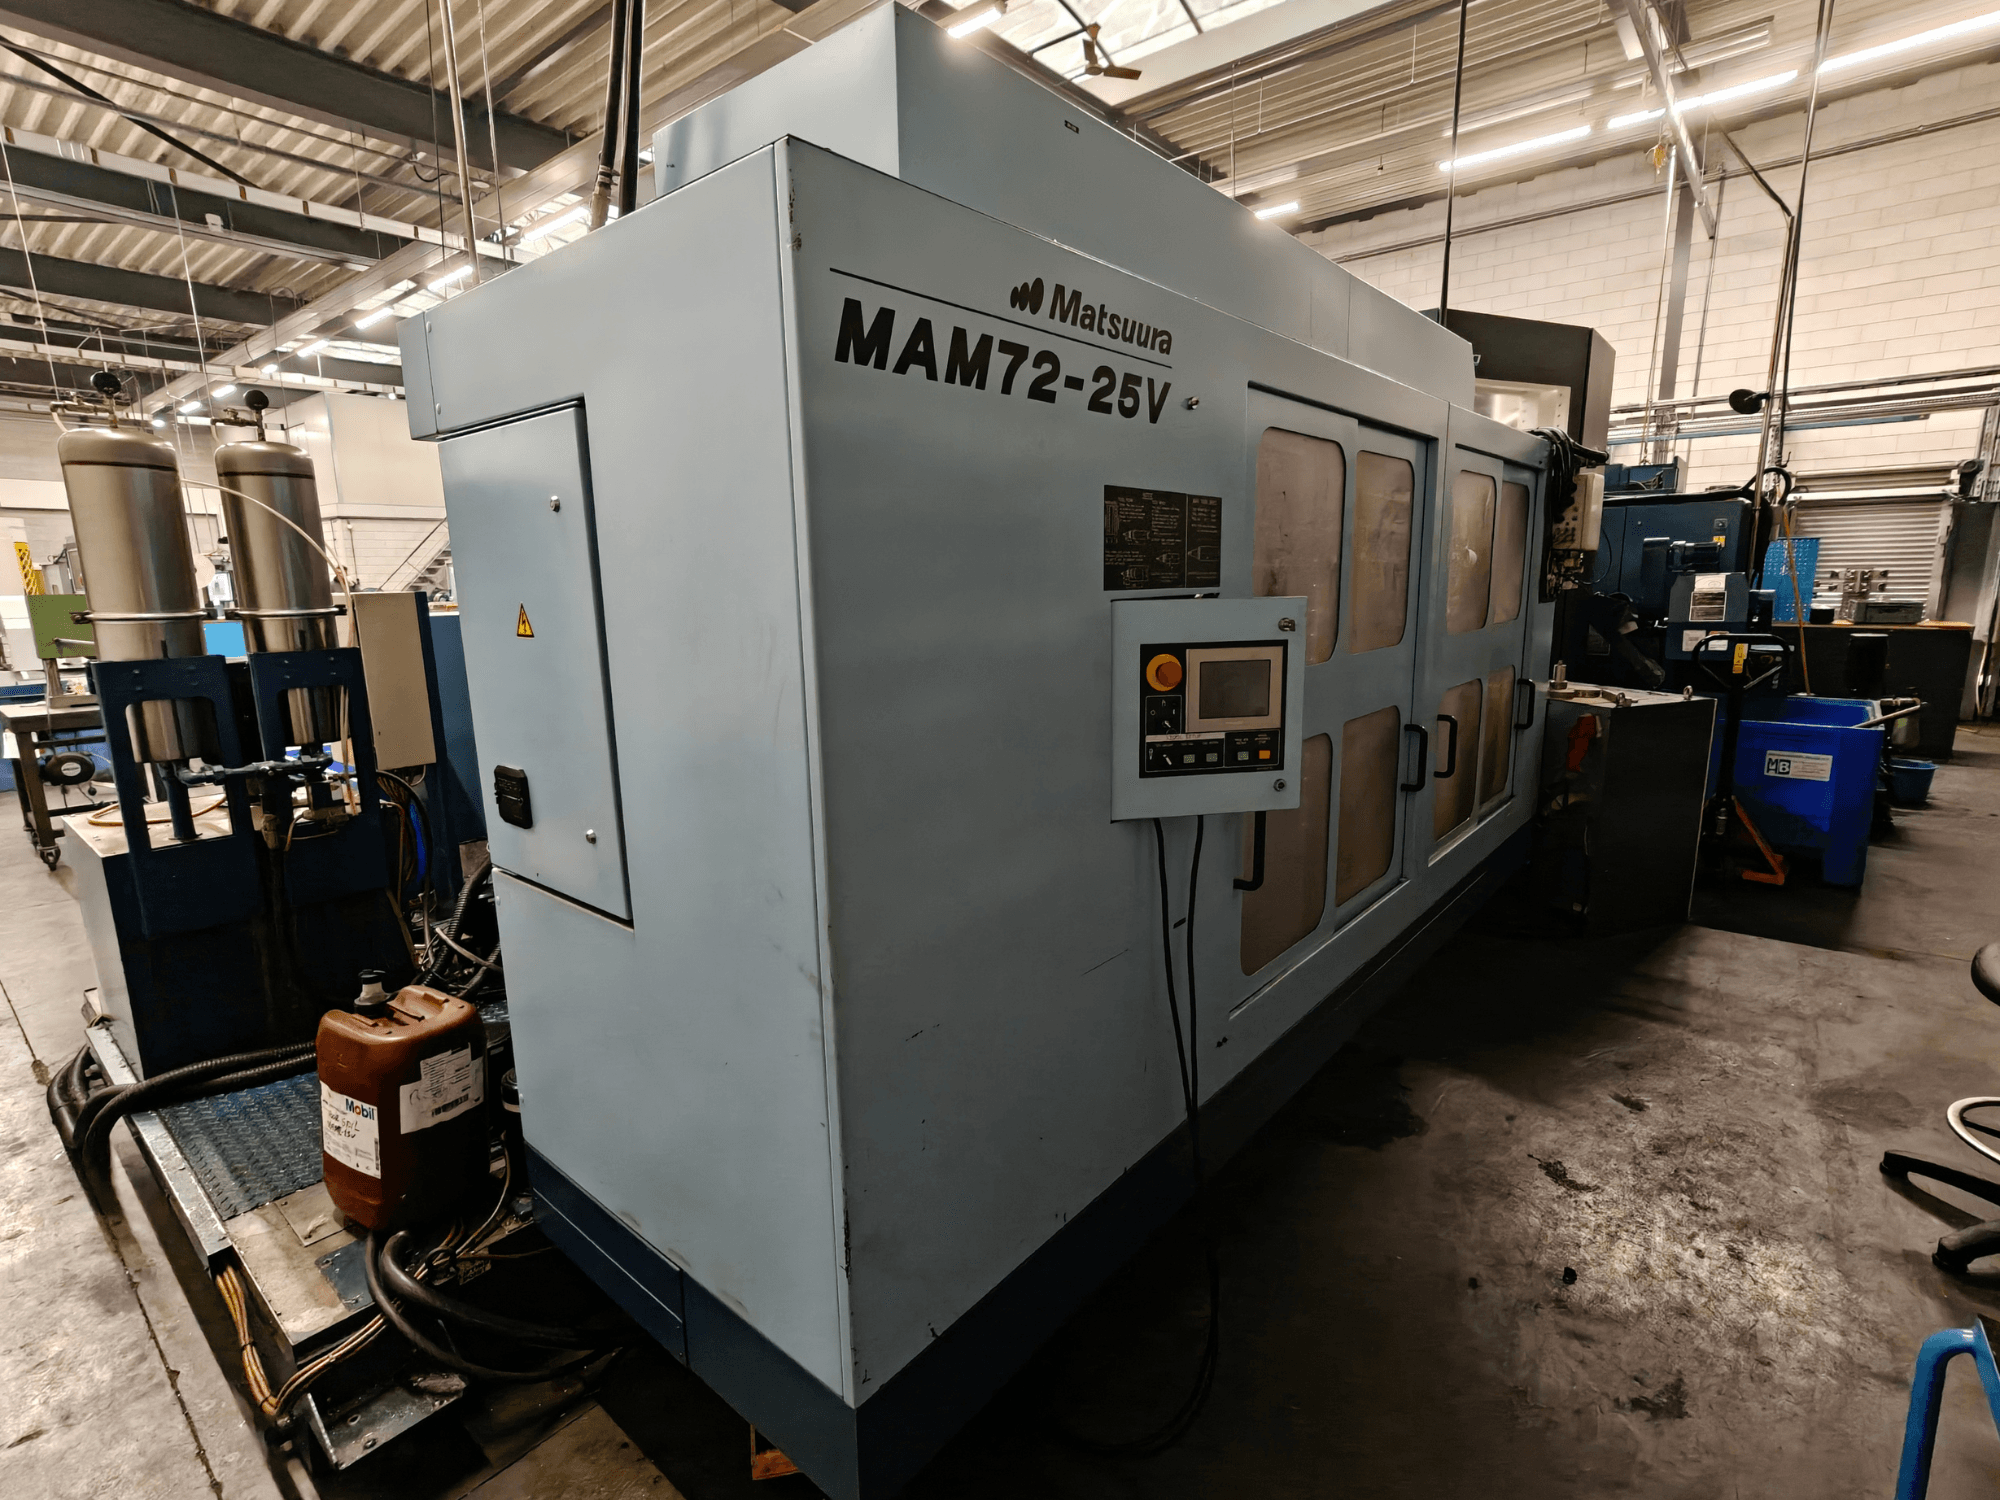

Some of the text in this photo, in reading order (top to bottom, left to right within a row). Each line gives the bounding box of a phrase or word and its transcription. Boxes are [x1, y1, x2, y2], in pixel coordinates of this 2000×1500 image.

[1048, 283, 1173, 355] Matsuura
[834, 297, 1172, 424] MAM72-25V
[345, 1098, 375, 1120] Mobil
